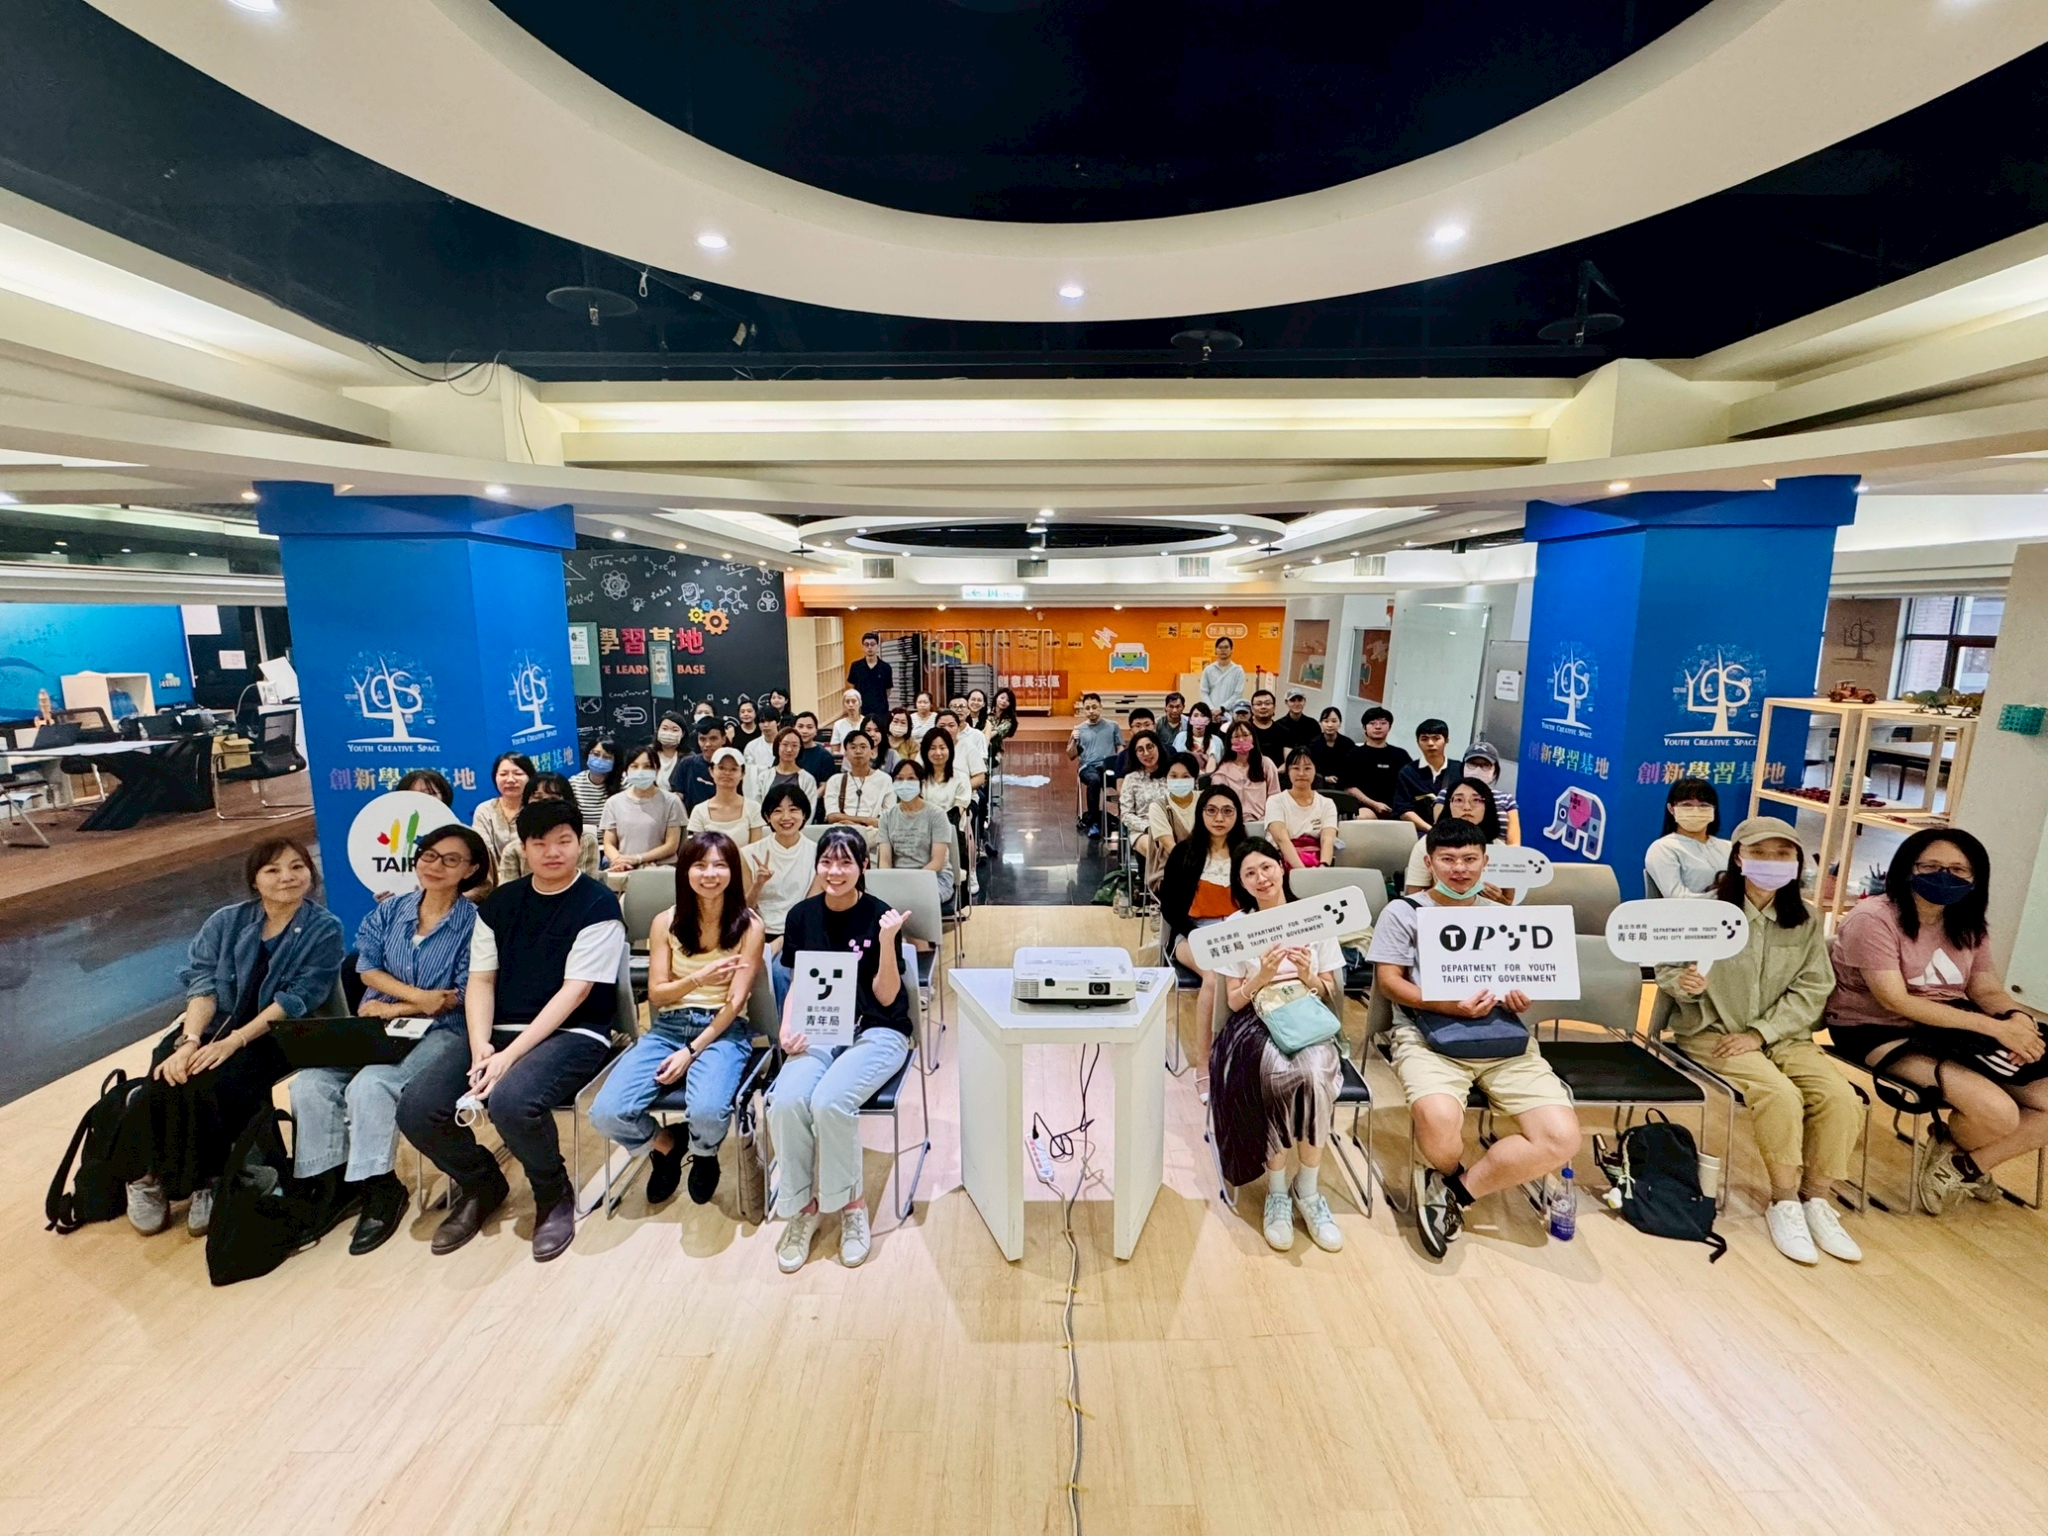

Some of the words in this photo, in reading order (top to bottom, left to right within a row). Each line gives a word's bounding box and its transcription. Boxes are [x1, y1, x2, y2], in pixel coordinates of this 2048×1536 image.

[677, 665, 706, 674] BASE
[1528, 741, 1610, 780] 創新學習基地
[1247, 924, 1284, 939] DEPARTMENT
[1288, 920, 1300, 928] FOR
[1303, 914, 1322, 924] YOUTH
[1250, 938, 1268, 947] TAIPEI
[1270, 934, 1283, 942] CITY
[1286, 922, 1324, 938] GOVERNMENT
[1617, 932, 1648, 942] 青年局
[1209, 941, 1245, 959] 青年局
[1441, 964, 1497, 973] DEPARTMENT
[1504, 963, 1521, 972] FOR
[1528, 963, 1556, 972] YOUTH
[1442, 974, 1469, 983] TAIPEI
[1474, 974, 1492, 982] CITY
[1498, 974, 1557, 982] GOVERNMENT
[806, 1015, 840, 1026] 青年局
